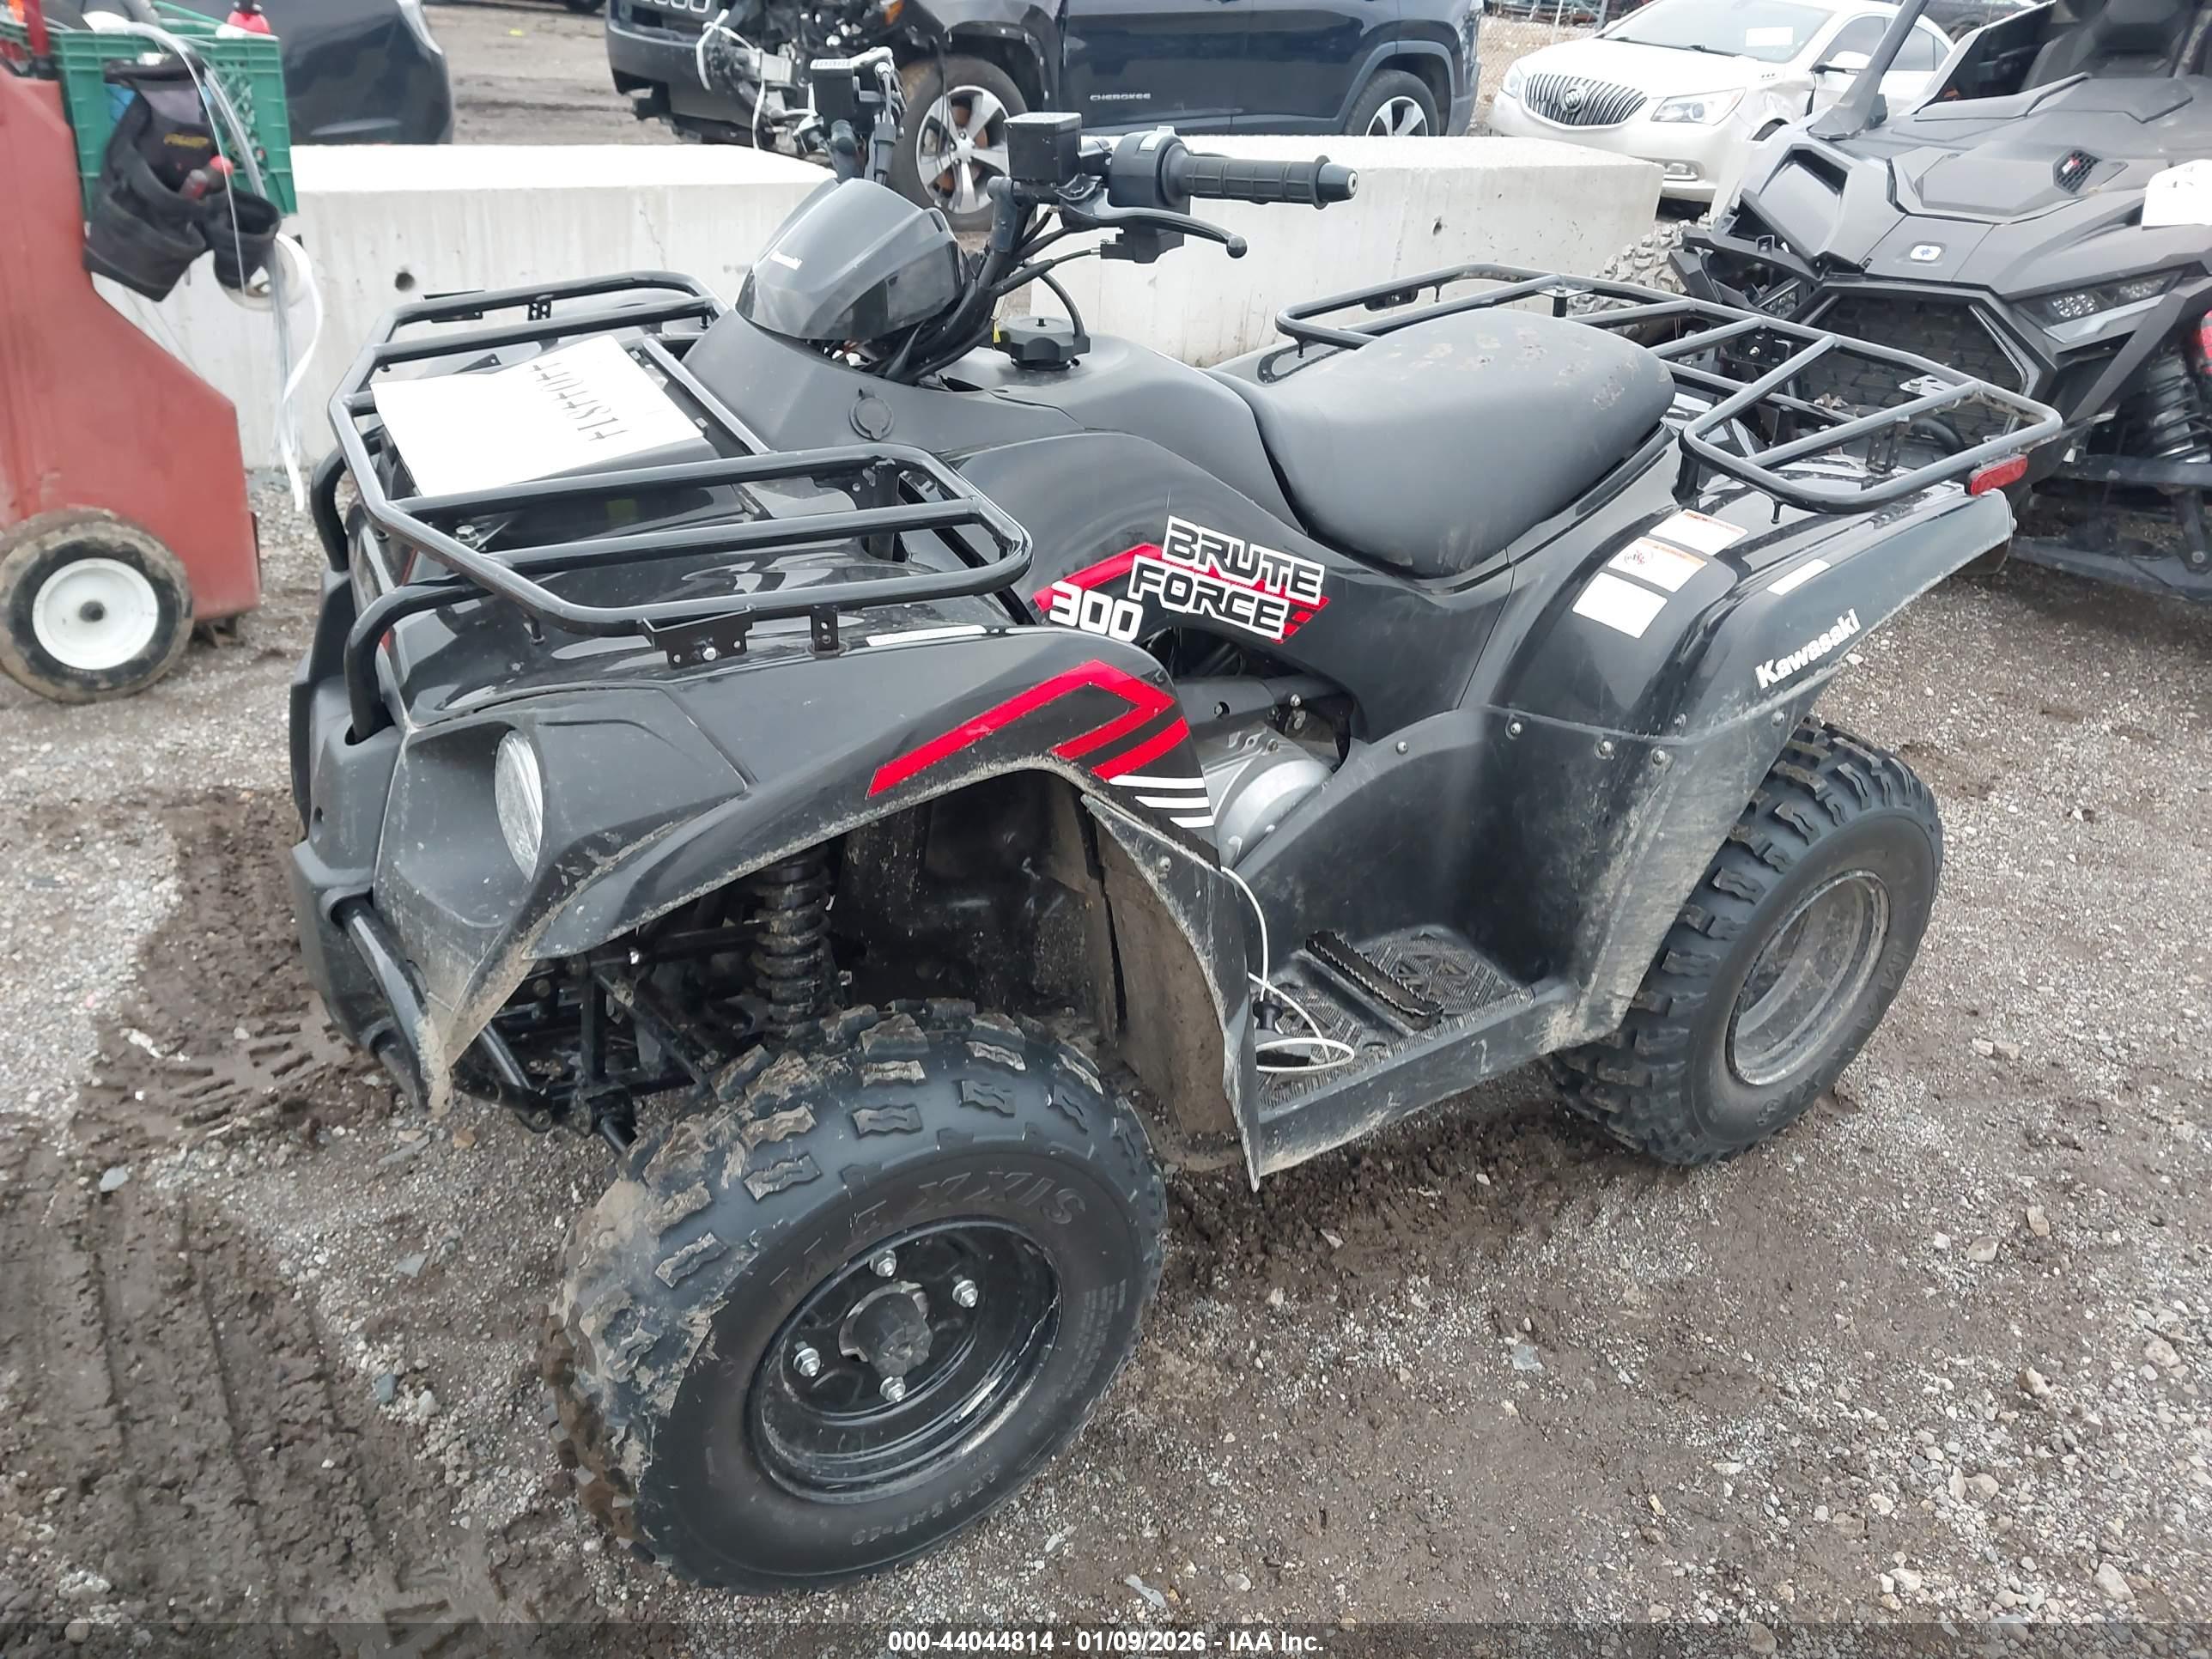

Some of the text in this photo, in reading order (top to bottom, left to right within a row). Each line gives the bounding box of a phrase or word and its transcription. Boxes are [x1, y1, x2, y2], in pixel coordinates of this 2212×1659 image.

[1127, 556, 1290, 640] FORCE
[1163, 516, 1325, 604] BRUTE
[1049, 580, 1143, 642] 300
[1755, 609, 1862, 688] Kawasaki
